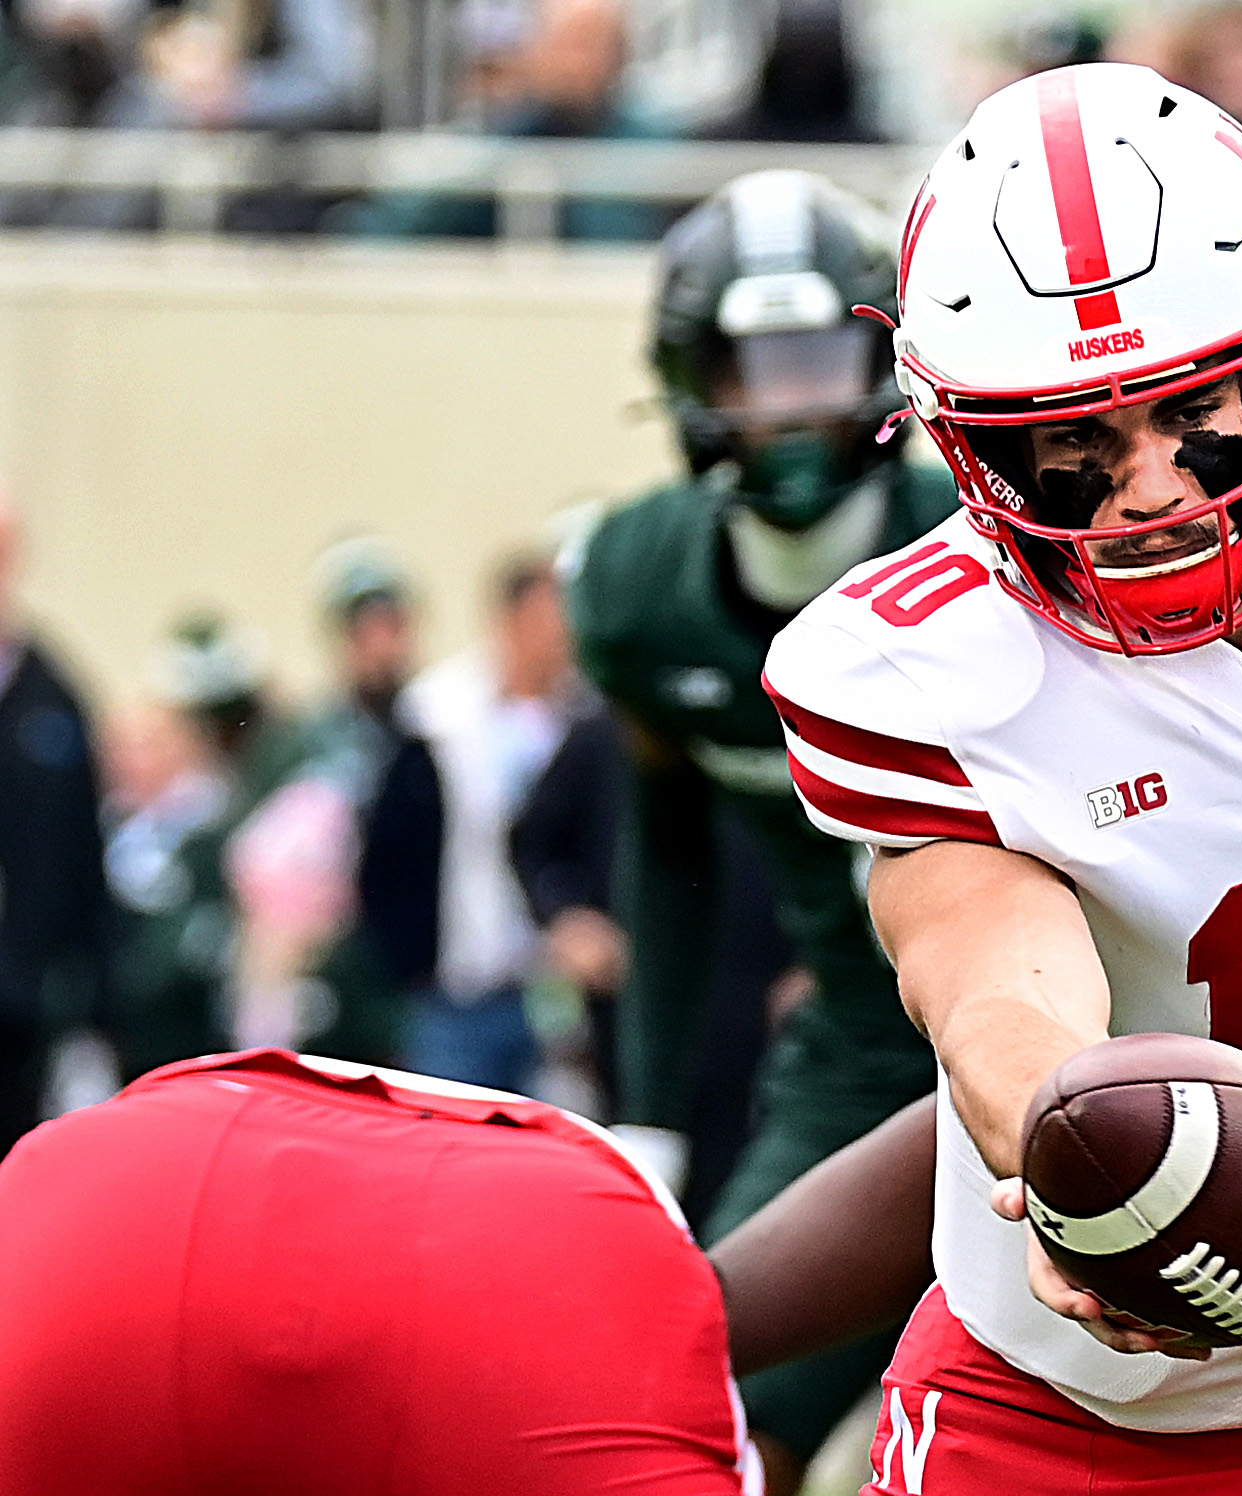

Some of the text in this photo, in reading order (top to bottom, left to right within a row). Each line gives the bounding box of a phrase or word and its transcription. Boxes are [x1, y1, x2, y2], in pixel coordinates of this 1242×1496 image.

[1067, 327, 1145, 363] HUSKERS
[838, 541, 991, 628] 10
[873, 1386, 943, 1496] N
